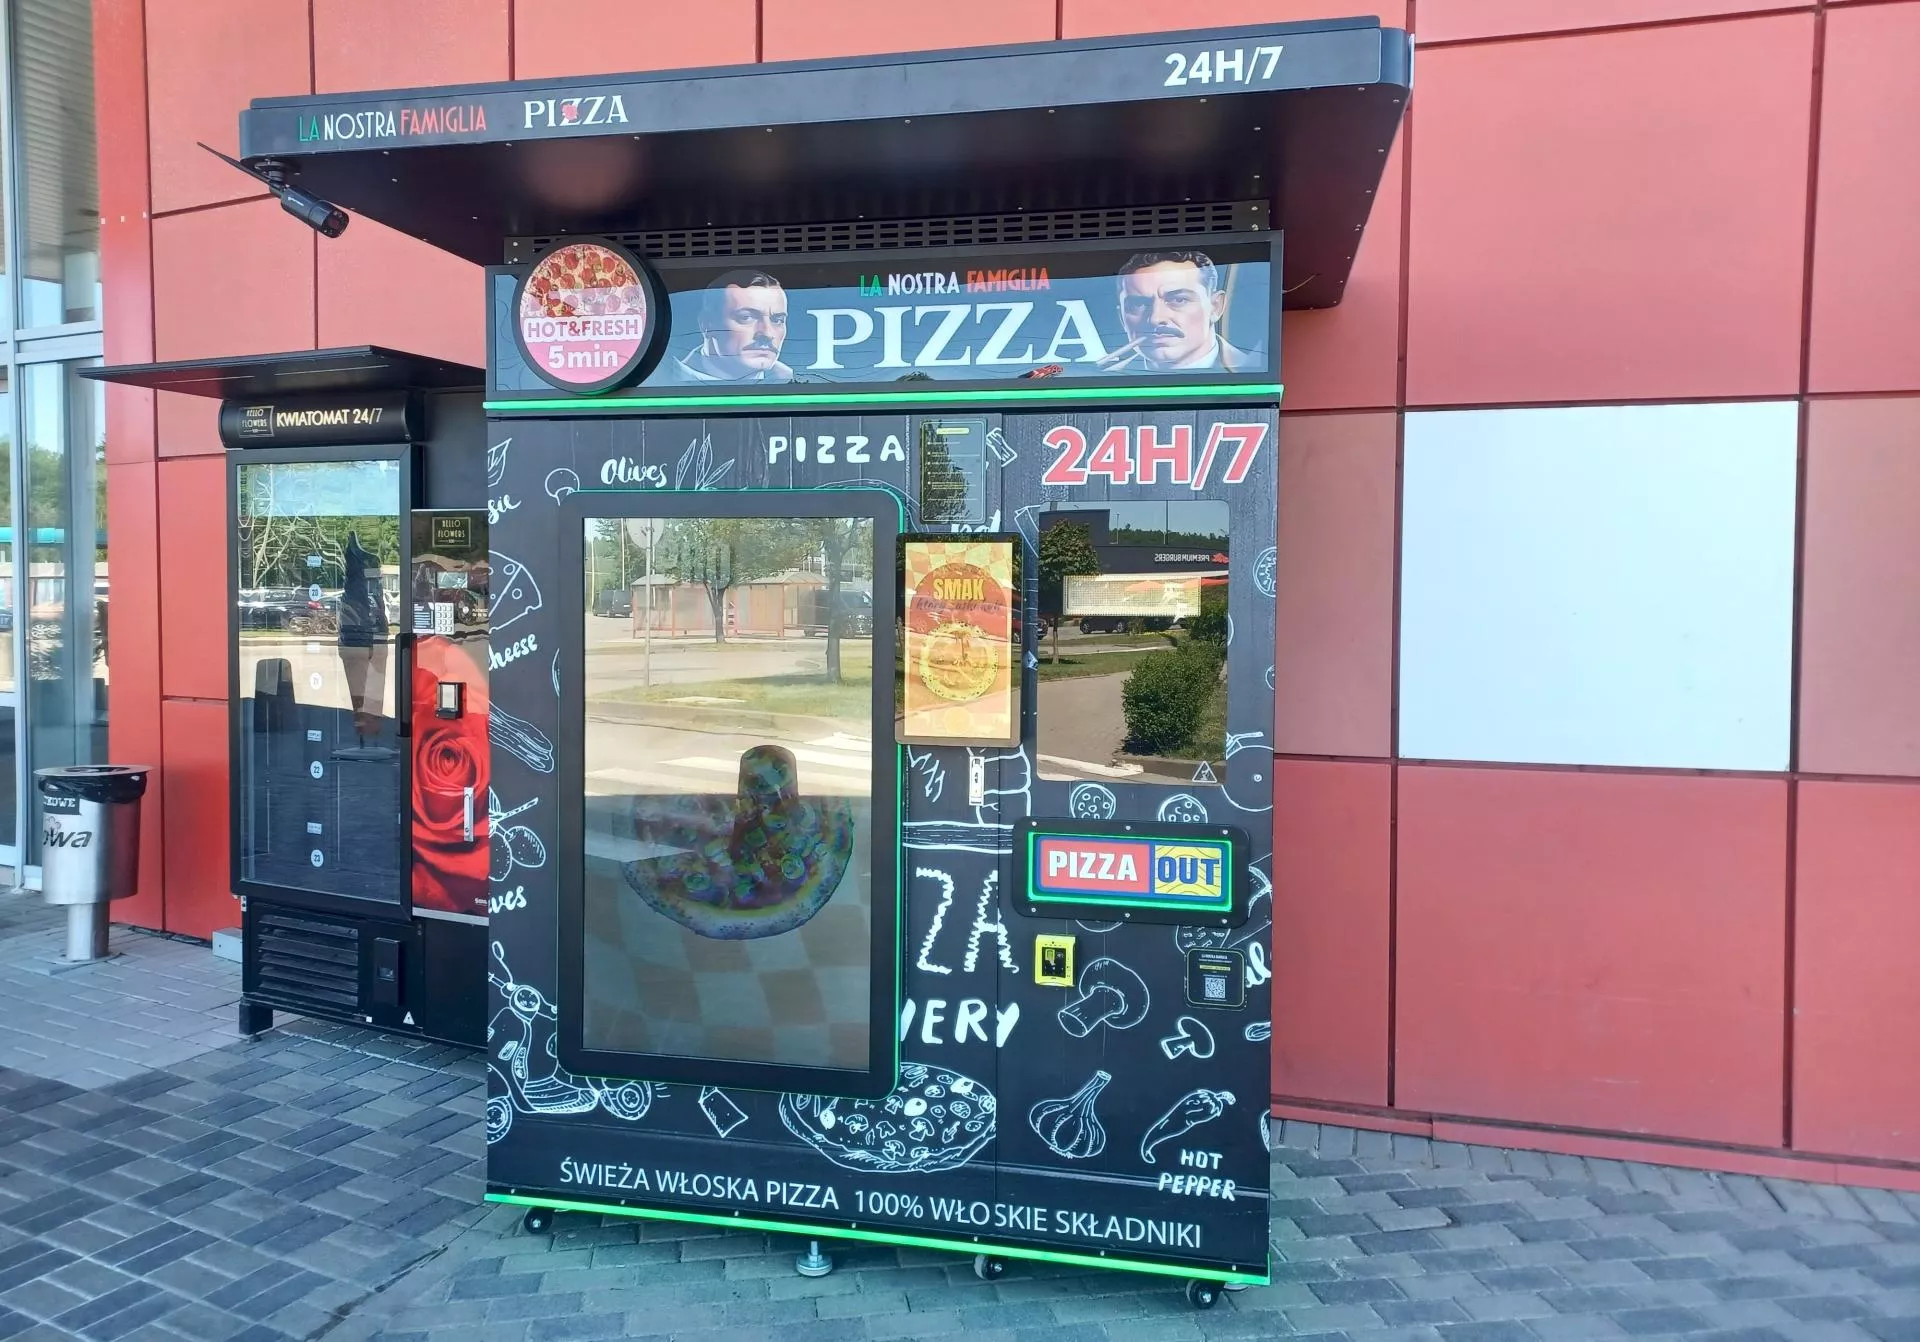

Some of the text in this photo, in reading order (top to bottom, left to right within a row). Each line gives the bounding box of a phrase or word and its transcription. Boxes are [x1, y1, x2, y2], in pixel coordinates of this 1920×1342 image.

[1163, 45, 1284, 87] 24H/7
[299, 105, 487, 142] LA NOSTRA FAMIGLIA
[524, 95, 629, 128] PIZZA
[859, 267, 1050, 297] LA NOSTRA FAMIGLIA
[528, 319, 639, 338] HOT&FRESH
[806, 300, 1110, 370] PIZZA
[276, 407, 383, 427] KWIATOMAT 24/7
[768, 434, 906, 464] PIZZA
[1042, 421, 1269, 491] 24H/7
[600, 456, 667, 488] Olives
[933, 578, 985, 600] SMAK
[1048, 850, 1220, 885] PIZZA OUT
[1181, 1148, 1223, 1170] HOT
[559, 1156, 1201, 1249] ŚWIEŻA WŁOSKA PIZZA 100% WŁOSKIE SKŁADNIKI
[1158, 1172, 1236, 1201] PEPPER
